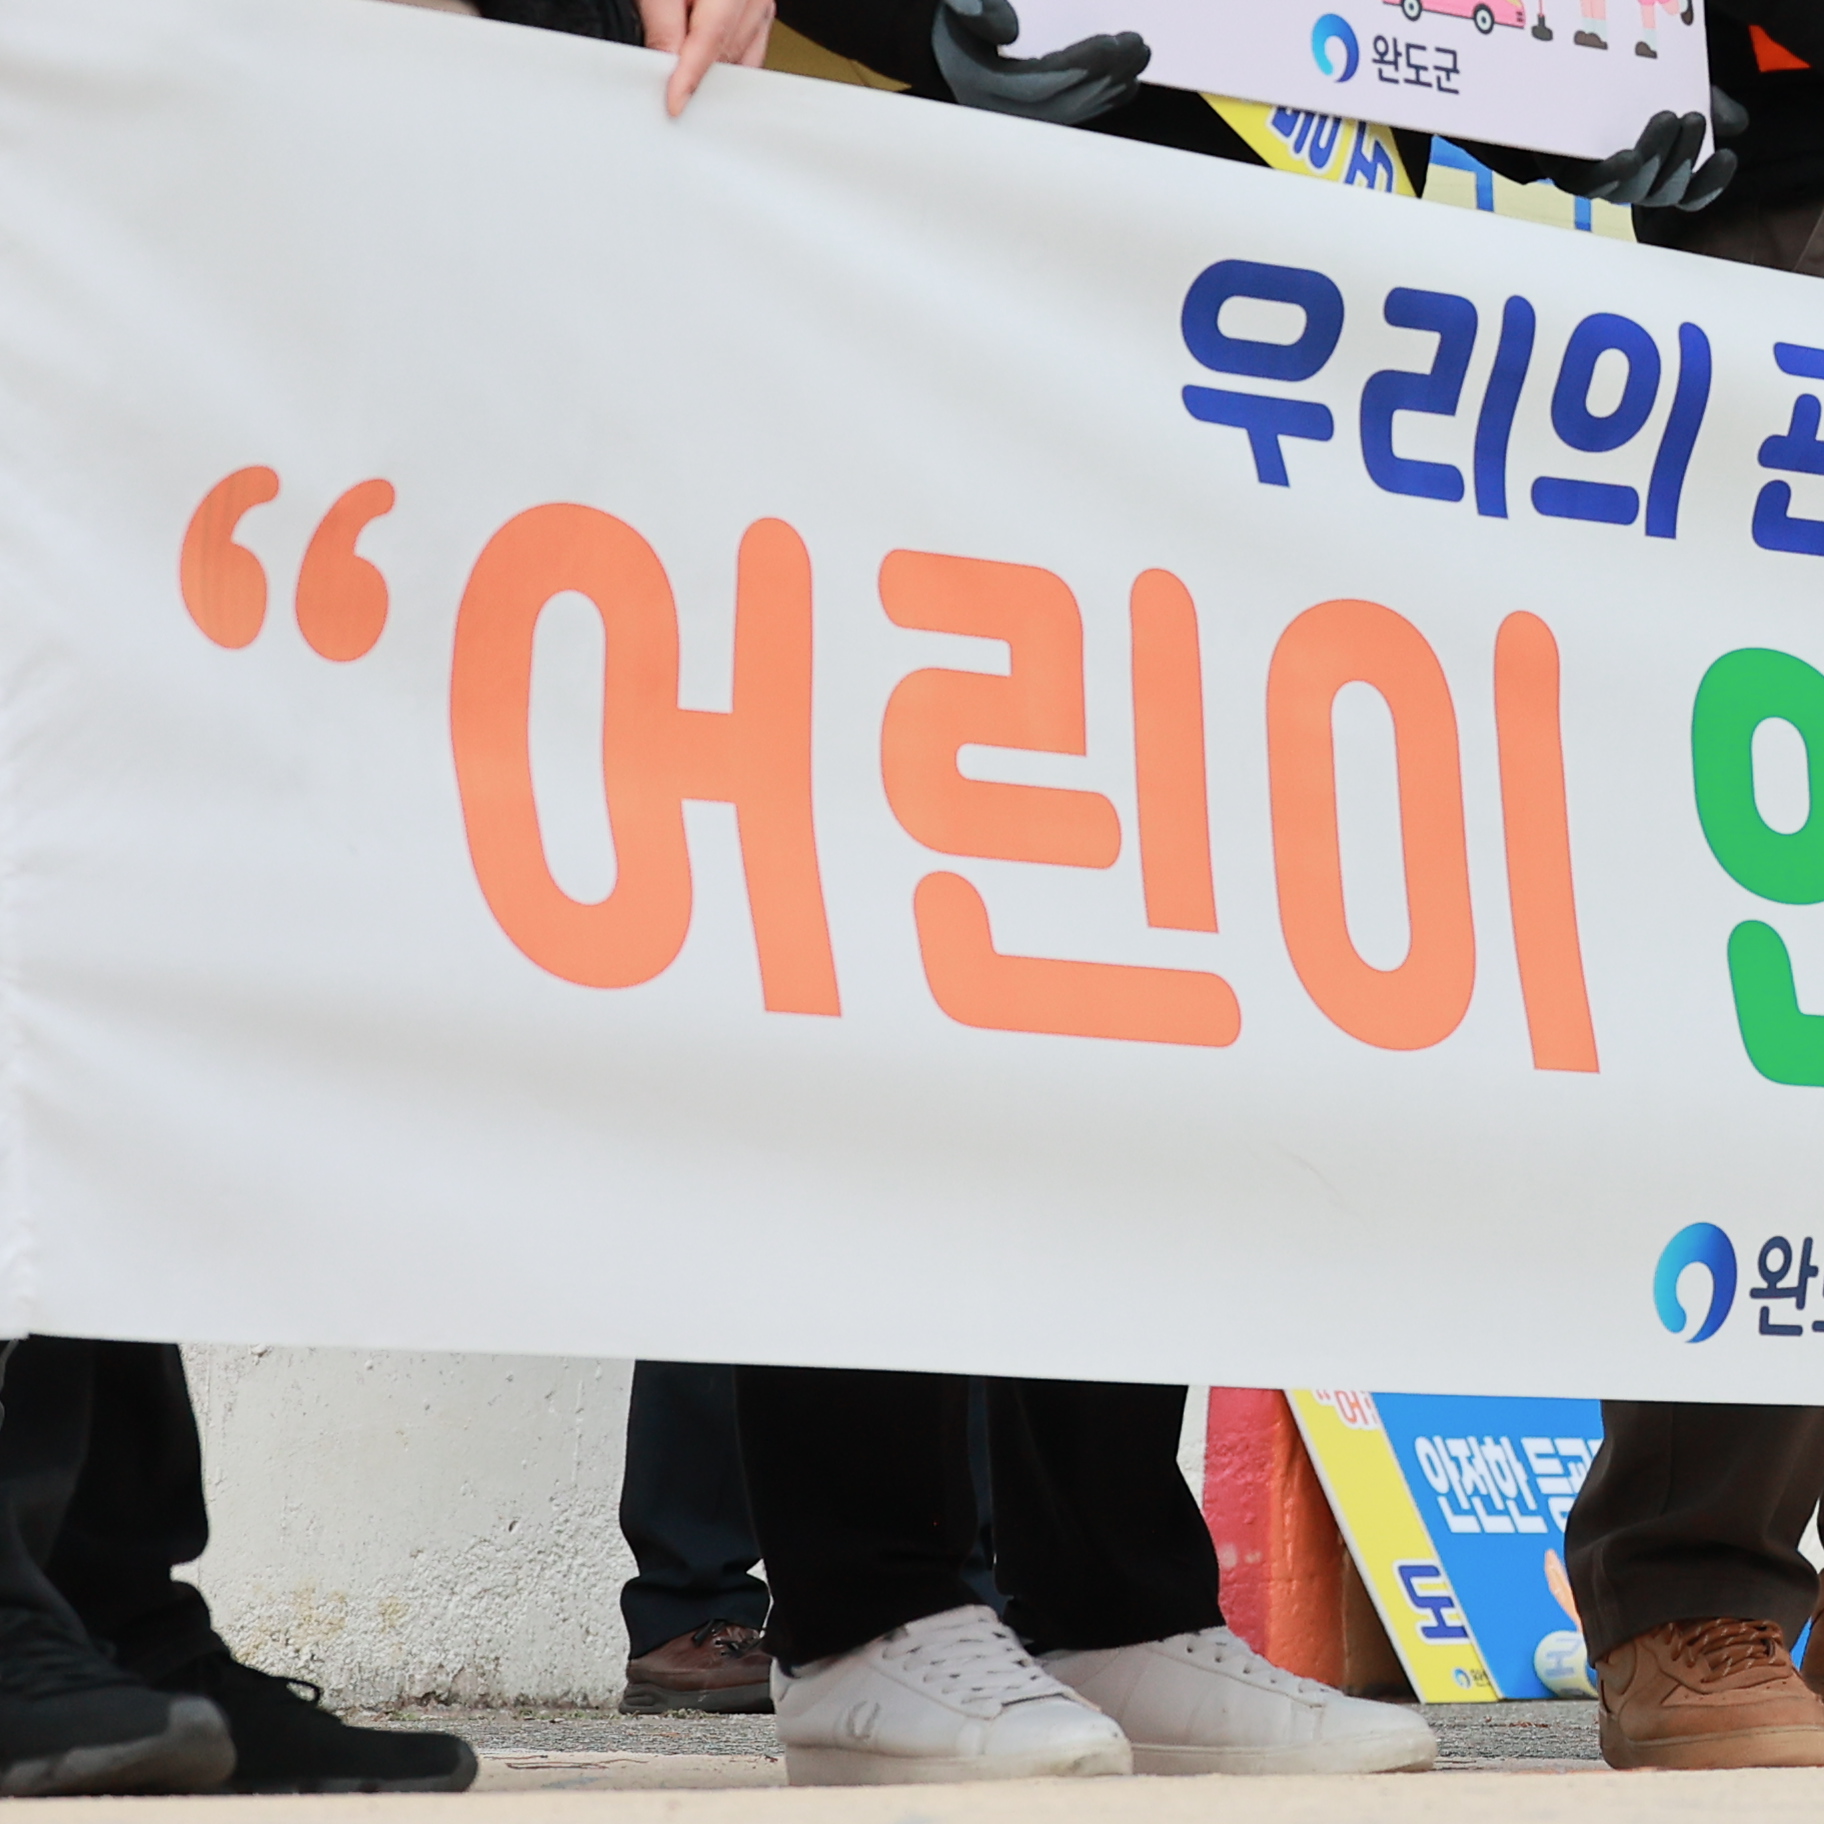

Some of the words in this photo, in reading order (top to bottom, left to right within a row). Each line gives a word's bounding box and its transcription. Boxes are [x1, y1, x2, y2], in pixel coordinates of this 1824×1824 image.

[1371, 33, 1461, 95] 완도군
[1180, 257, 1710, 540] 우리의
[179, 464, 1602, 1074] “어린이
[1414, 1435, 1549, 1534] 안전한
